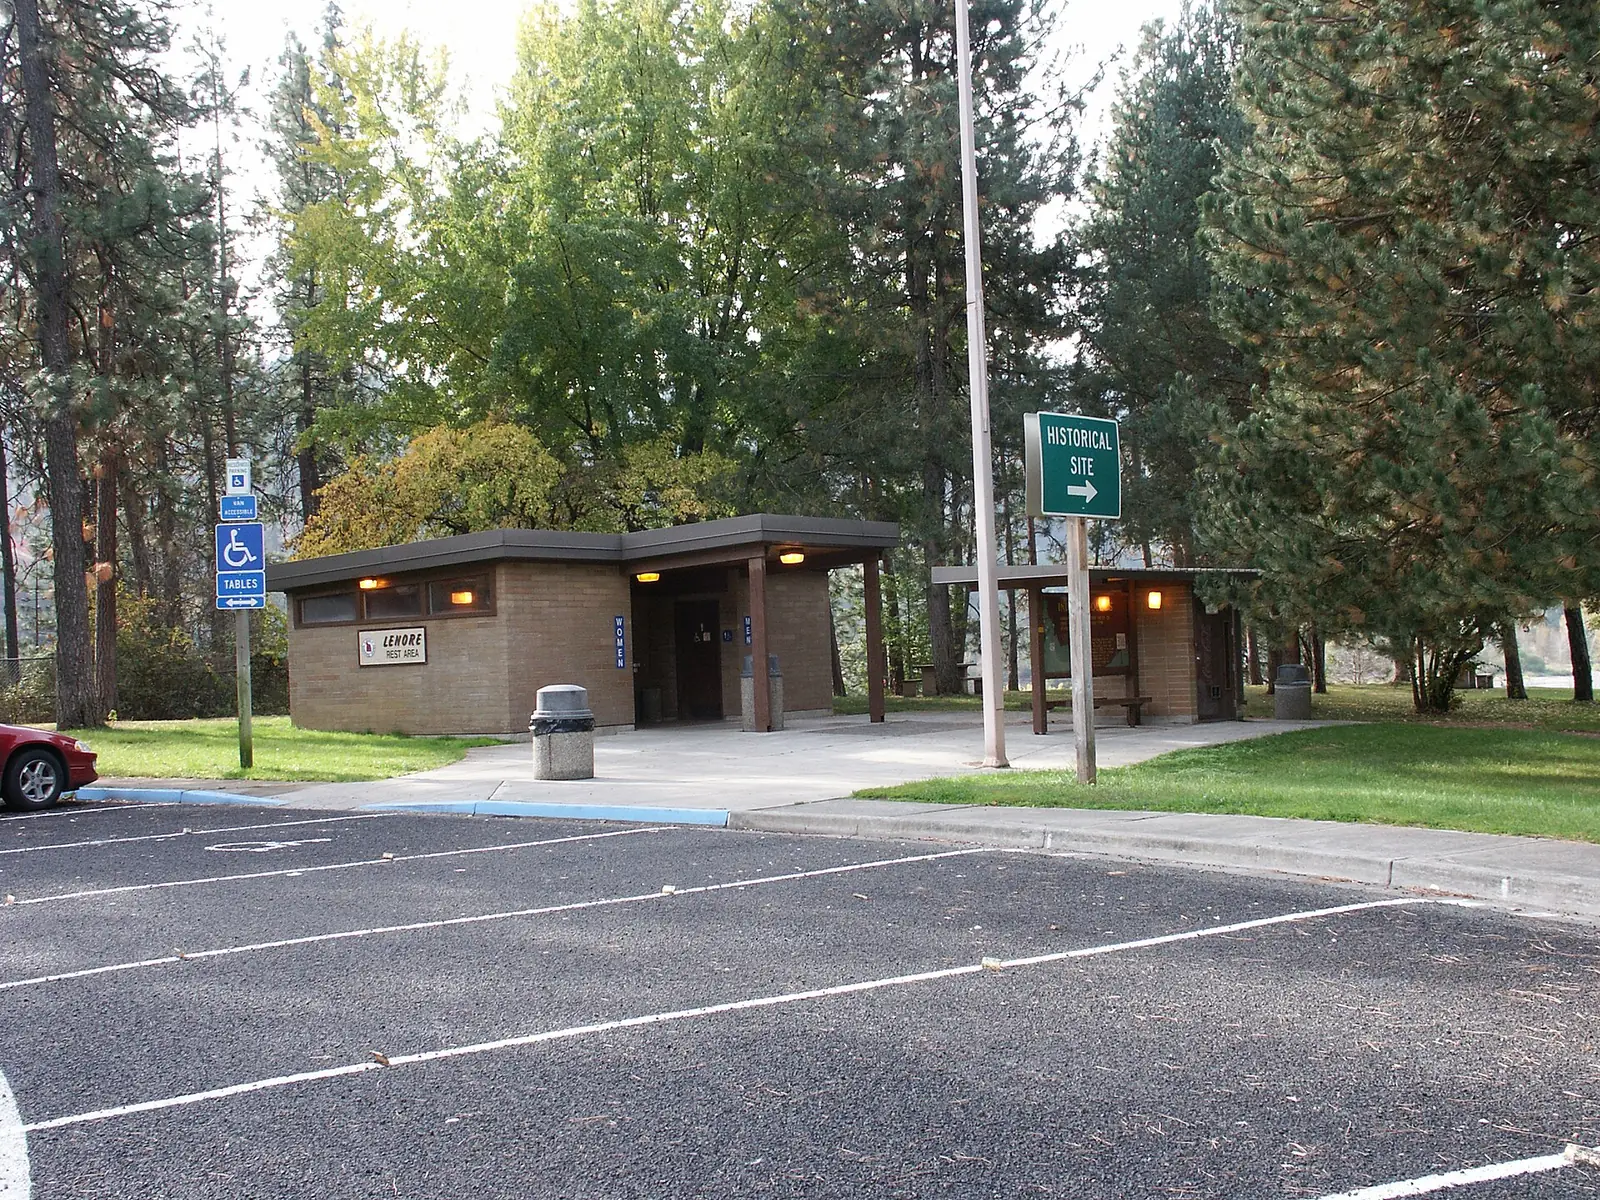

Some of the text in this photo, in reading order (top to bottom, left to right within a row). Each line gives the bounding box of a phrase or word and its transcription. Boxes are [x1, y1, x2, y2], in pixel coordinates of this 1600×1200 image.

[1047, 425, 1113, 451] HISTORICAL
[1070, 456, 1095, 476] SITE
[224, 508, 253, 516] ACCESSIBLE
[224, 579, 258, 590] TABLES
[744, 617, 752, 644] MEN
[383, 633, 422, 648] LENORE
[615, 617, 624, 668] WOMEN
[386, 648, 420, 659] REST AREA
